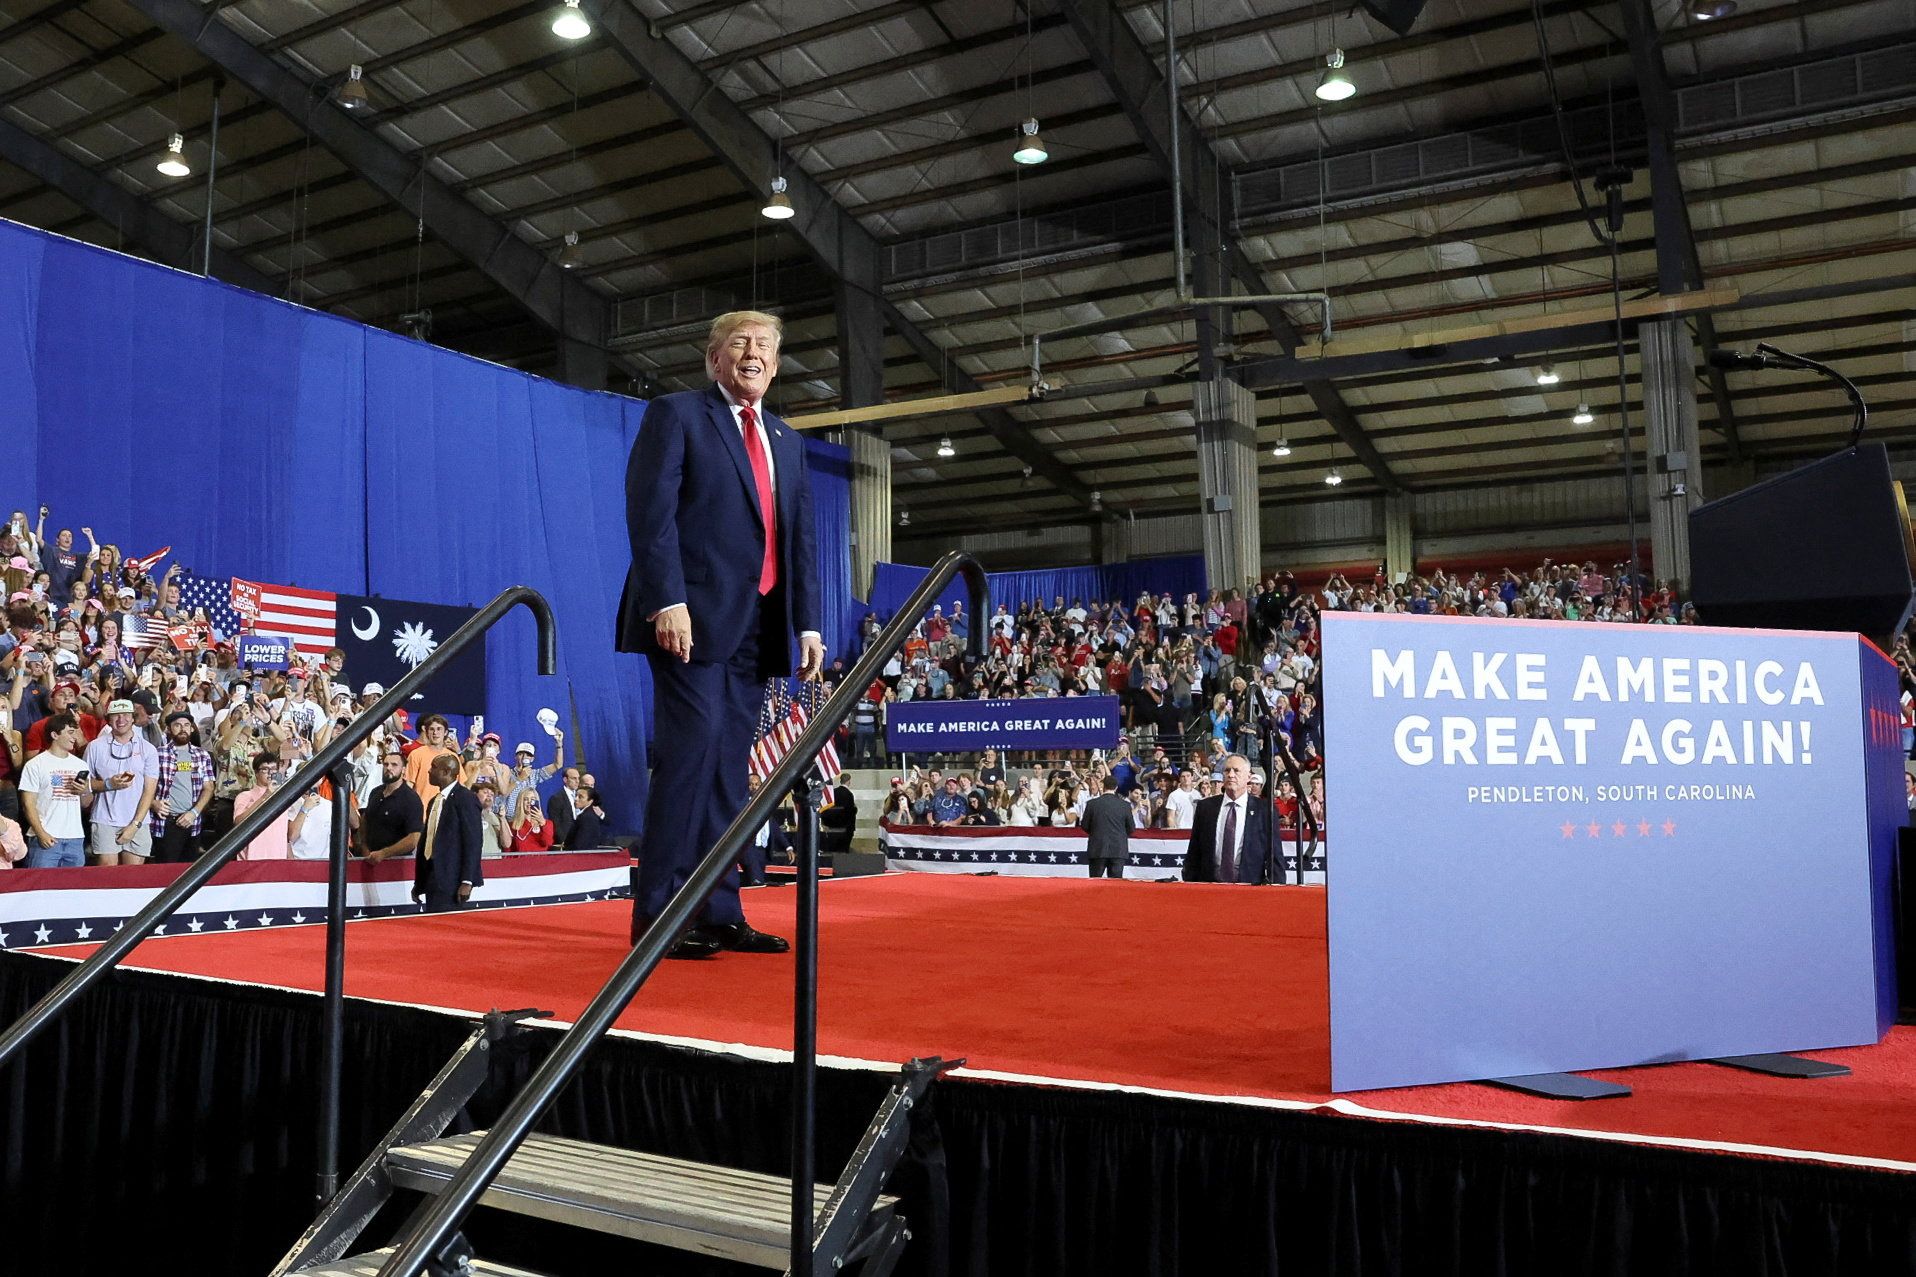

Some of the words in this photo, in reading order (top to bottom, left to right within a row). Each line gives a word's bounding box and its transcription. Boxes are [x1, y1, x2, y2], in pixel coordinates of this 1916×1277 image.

[236, 583, 245, 591] NO
[246, 586, 256, 595] TAX
[236, 595, 255, 606] SOCIAL
[233, 601, 259, 614] SECURITY
[170, 628, 187, 636] NO
[190, 625, 210, 633] TAX
[244, 644, 285, 655] LOWER
[244, 653, 284, 663] PRICES
[1371, 648, 1548, 701] MAKE
[1572, 654, 1825, 706] AMERICA
[897, 722, 934, 733] MAKE
[938, 720, 1000, 732] AMERICA
[1004, 719, 1051, 731] GREAT
[1055, 717, 1106, 730] AGAIN!
[1393, 715, 1596, 766] GREAT
[1620, 718, 1812, 766] AGAIN!
[1467, 785, 1589, 804] PENDLETON,
[1597, 785, 1658, 802] SOUTH
[1665, 784, 1756, 801] CAROLINA
